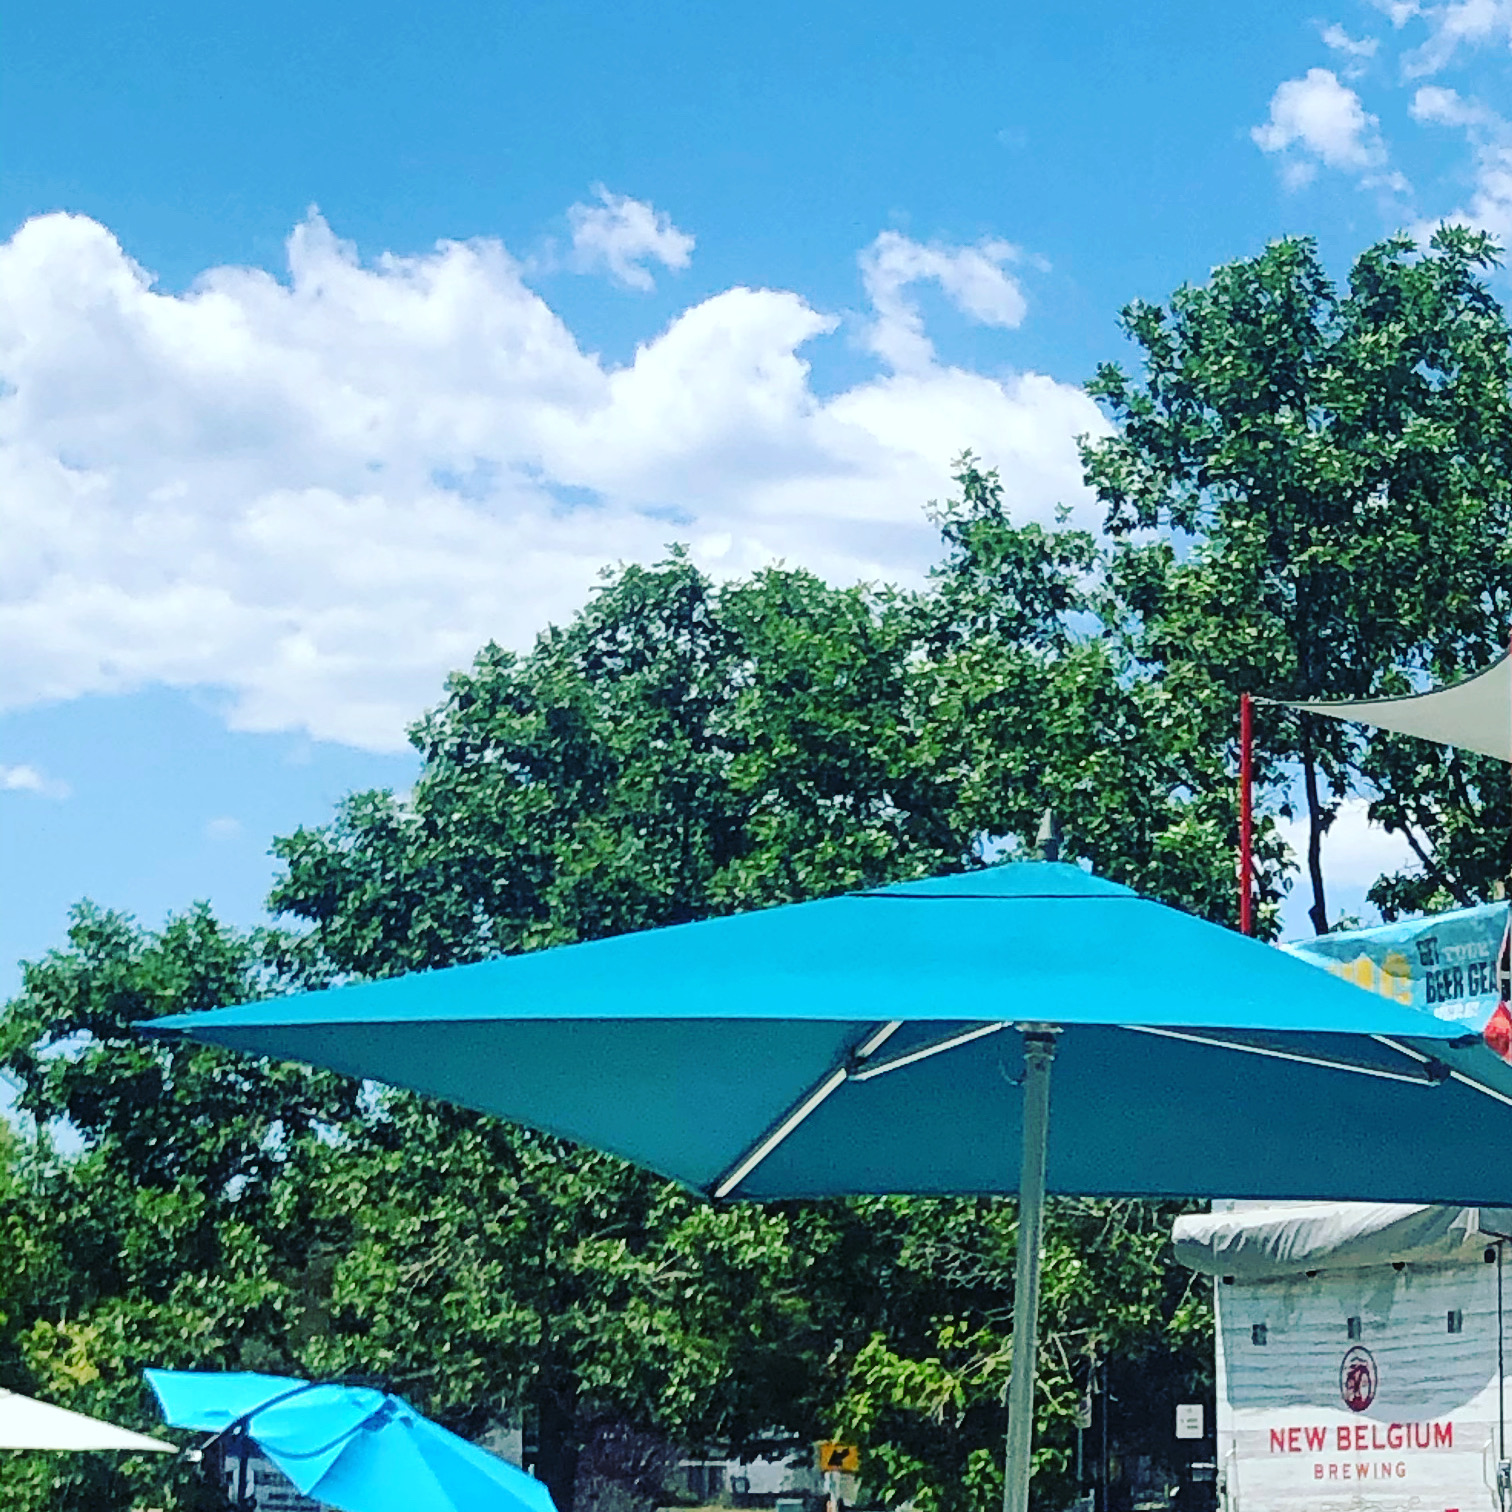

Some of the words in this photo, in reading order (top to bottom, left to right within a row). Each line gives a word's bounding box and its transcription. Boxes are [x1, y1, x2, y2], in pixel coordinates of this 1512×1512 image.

[1426, 966, 1464, 1004] BEER
[1467, 960, 1500, 997] GEA
[1269, 1426, 1328, 1453] NEW
[1336, 1421, 1453, 1451] BELGIUM
[1313, 1461, 1407, 1480] BREWING
